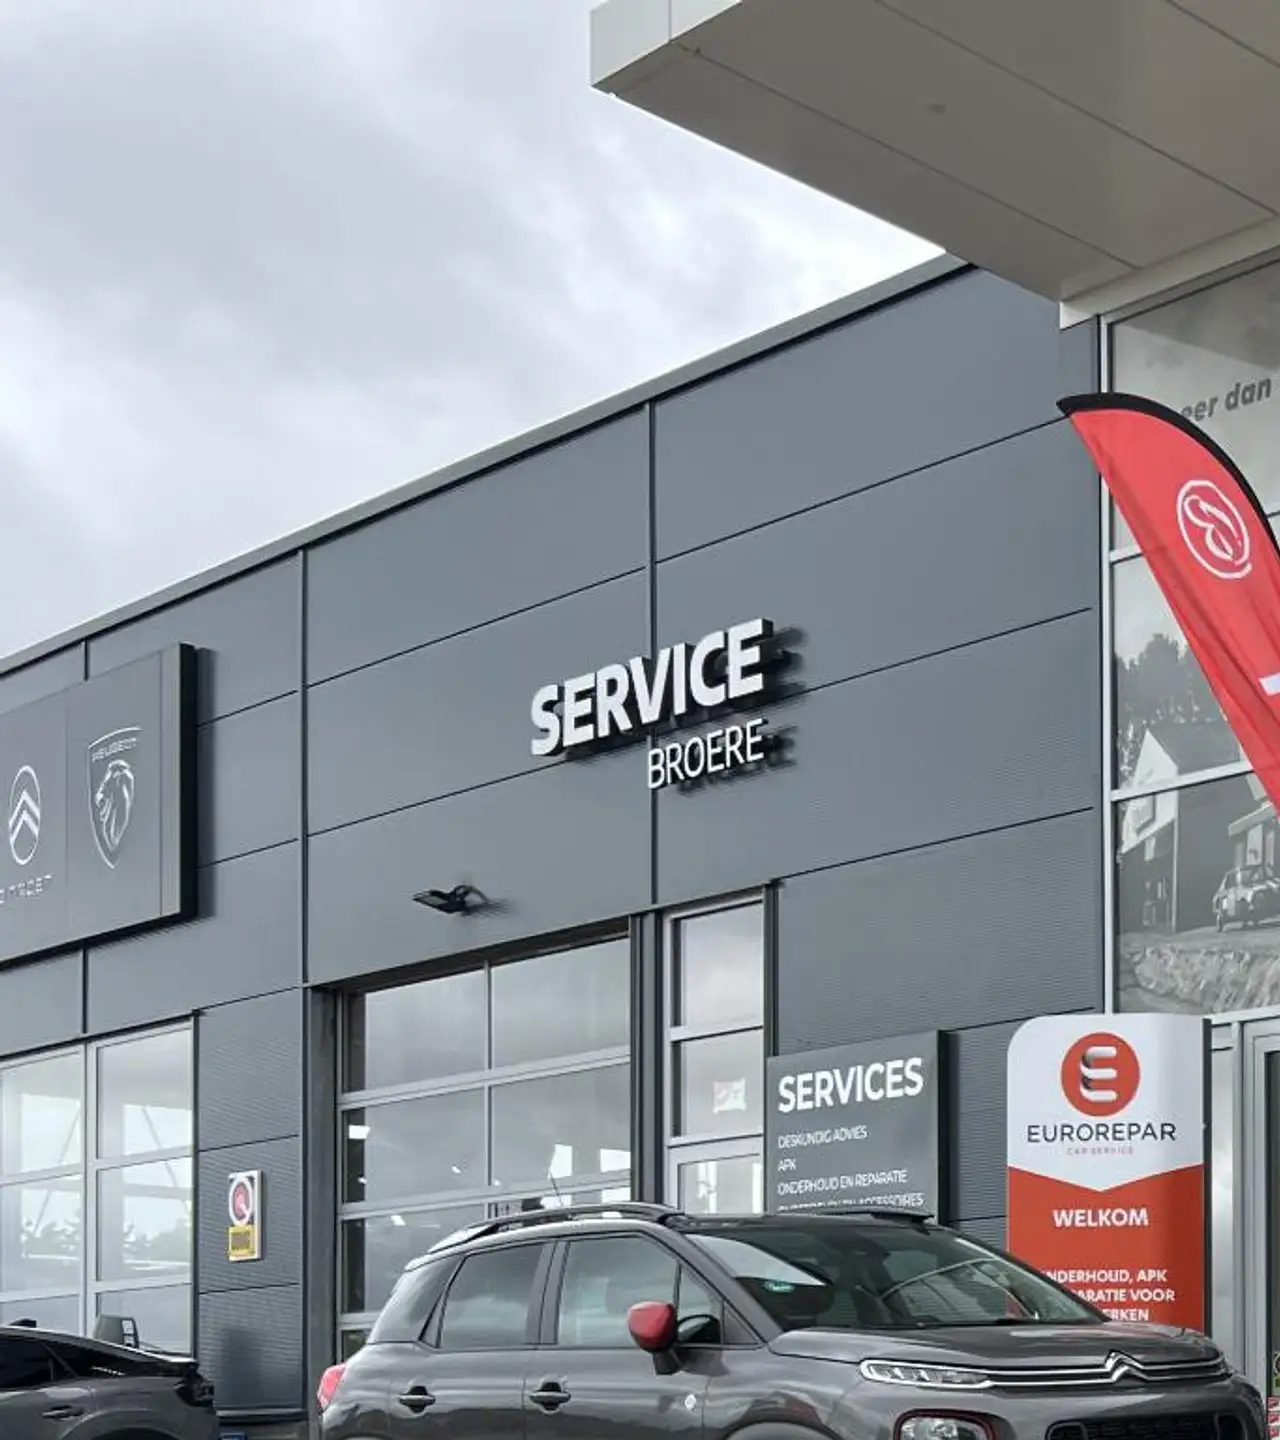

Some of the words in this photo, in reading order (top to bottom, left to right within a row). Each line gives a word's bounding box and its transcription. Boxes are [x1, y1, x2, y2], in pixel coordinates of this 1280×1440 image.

[1179, 396, 1219, 421] eer
[1225, 378, 1271, 411] dan
[530, 618, 766, 756] SERVICE
[647, 718, 765, 790] BROERE
[778, 1057, 924, 1114] SERVICES
[778, 1129, 832, 1149] DESKUNDIG
[833, 1125, 868, 1141] ADVIES
[1027, 1122, 1177, 1144] EUROREPAR
[778, 1158, 797, 1172] APK
[778, 1176, 839, 1196] ONDERHOUD
[840, 1176, 854, 1188] EN
[855, 1169, 908, 1188] REPARATIE
[1053, 1207, 1149, 1228] WELKOM
[1042, 1269, 1134, 1285] NDERHOUD,
[1136, 1269, 1168, 1282] APK
[1071, 1288, 1127, 1303] ARATIE
[1130, 1288, 1176, 1302] VOOR
[1102, 1308, 1149, 1321] ERKEN
